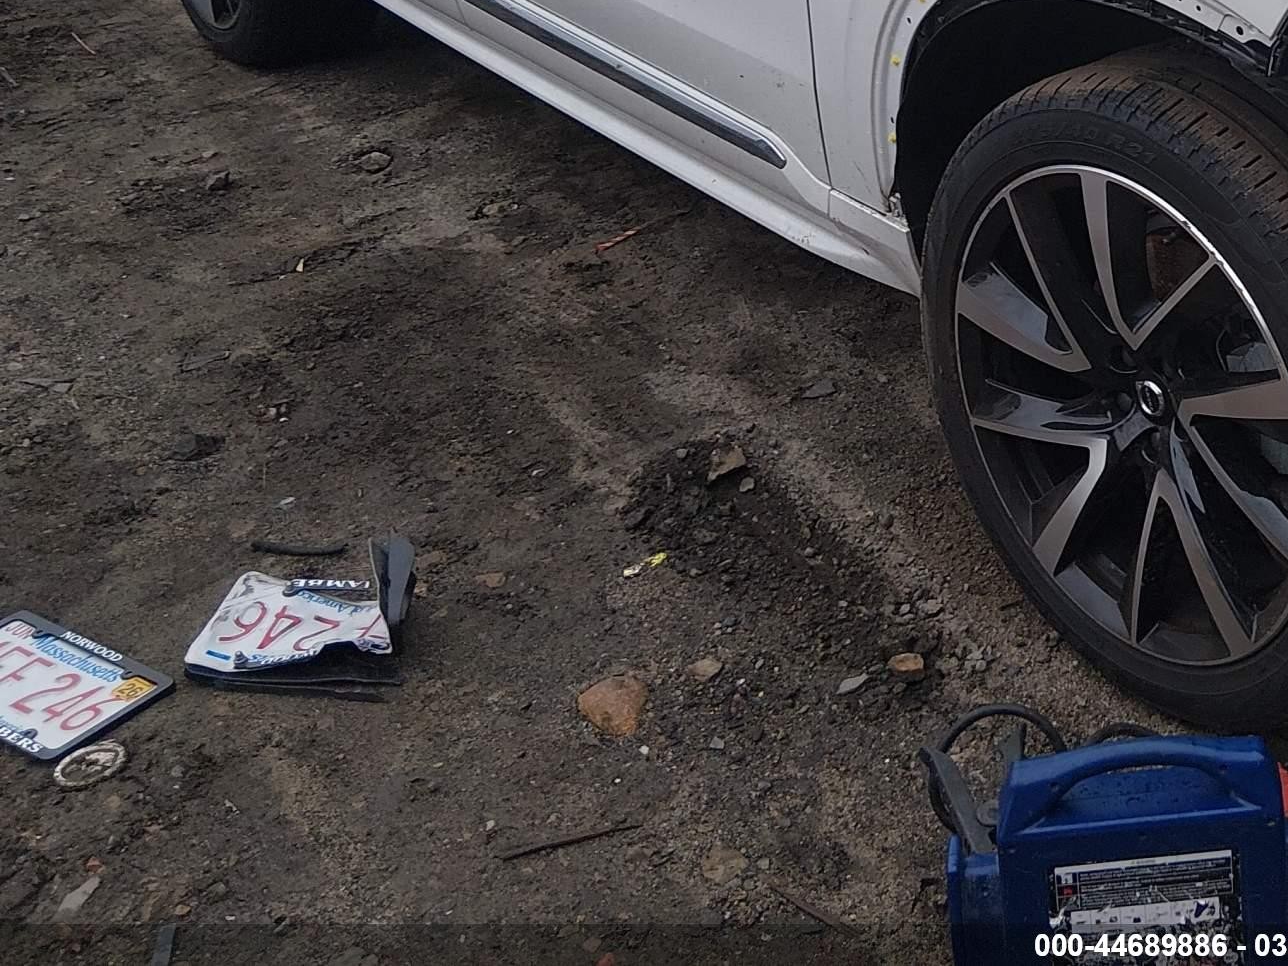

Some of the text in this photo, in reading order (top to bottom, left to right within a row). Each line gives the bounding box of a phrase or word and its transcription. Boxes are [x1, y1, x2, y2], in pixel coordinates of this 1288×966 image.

[5, 621, 35, 640] JUN
[60, 631, 123, 662] NORWOOD
[218, 601, 341, 652] 246
[31, 635, 123, 684] Massachusetts
[9, 672, 124, 732] 246
[119, 682, 143, 698] 26
